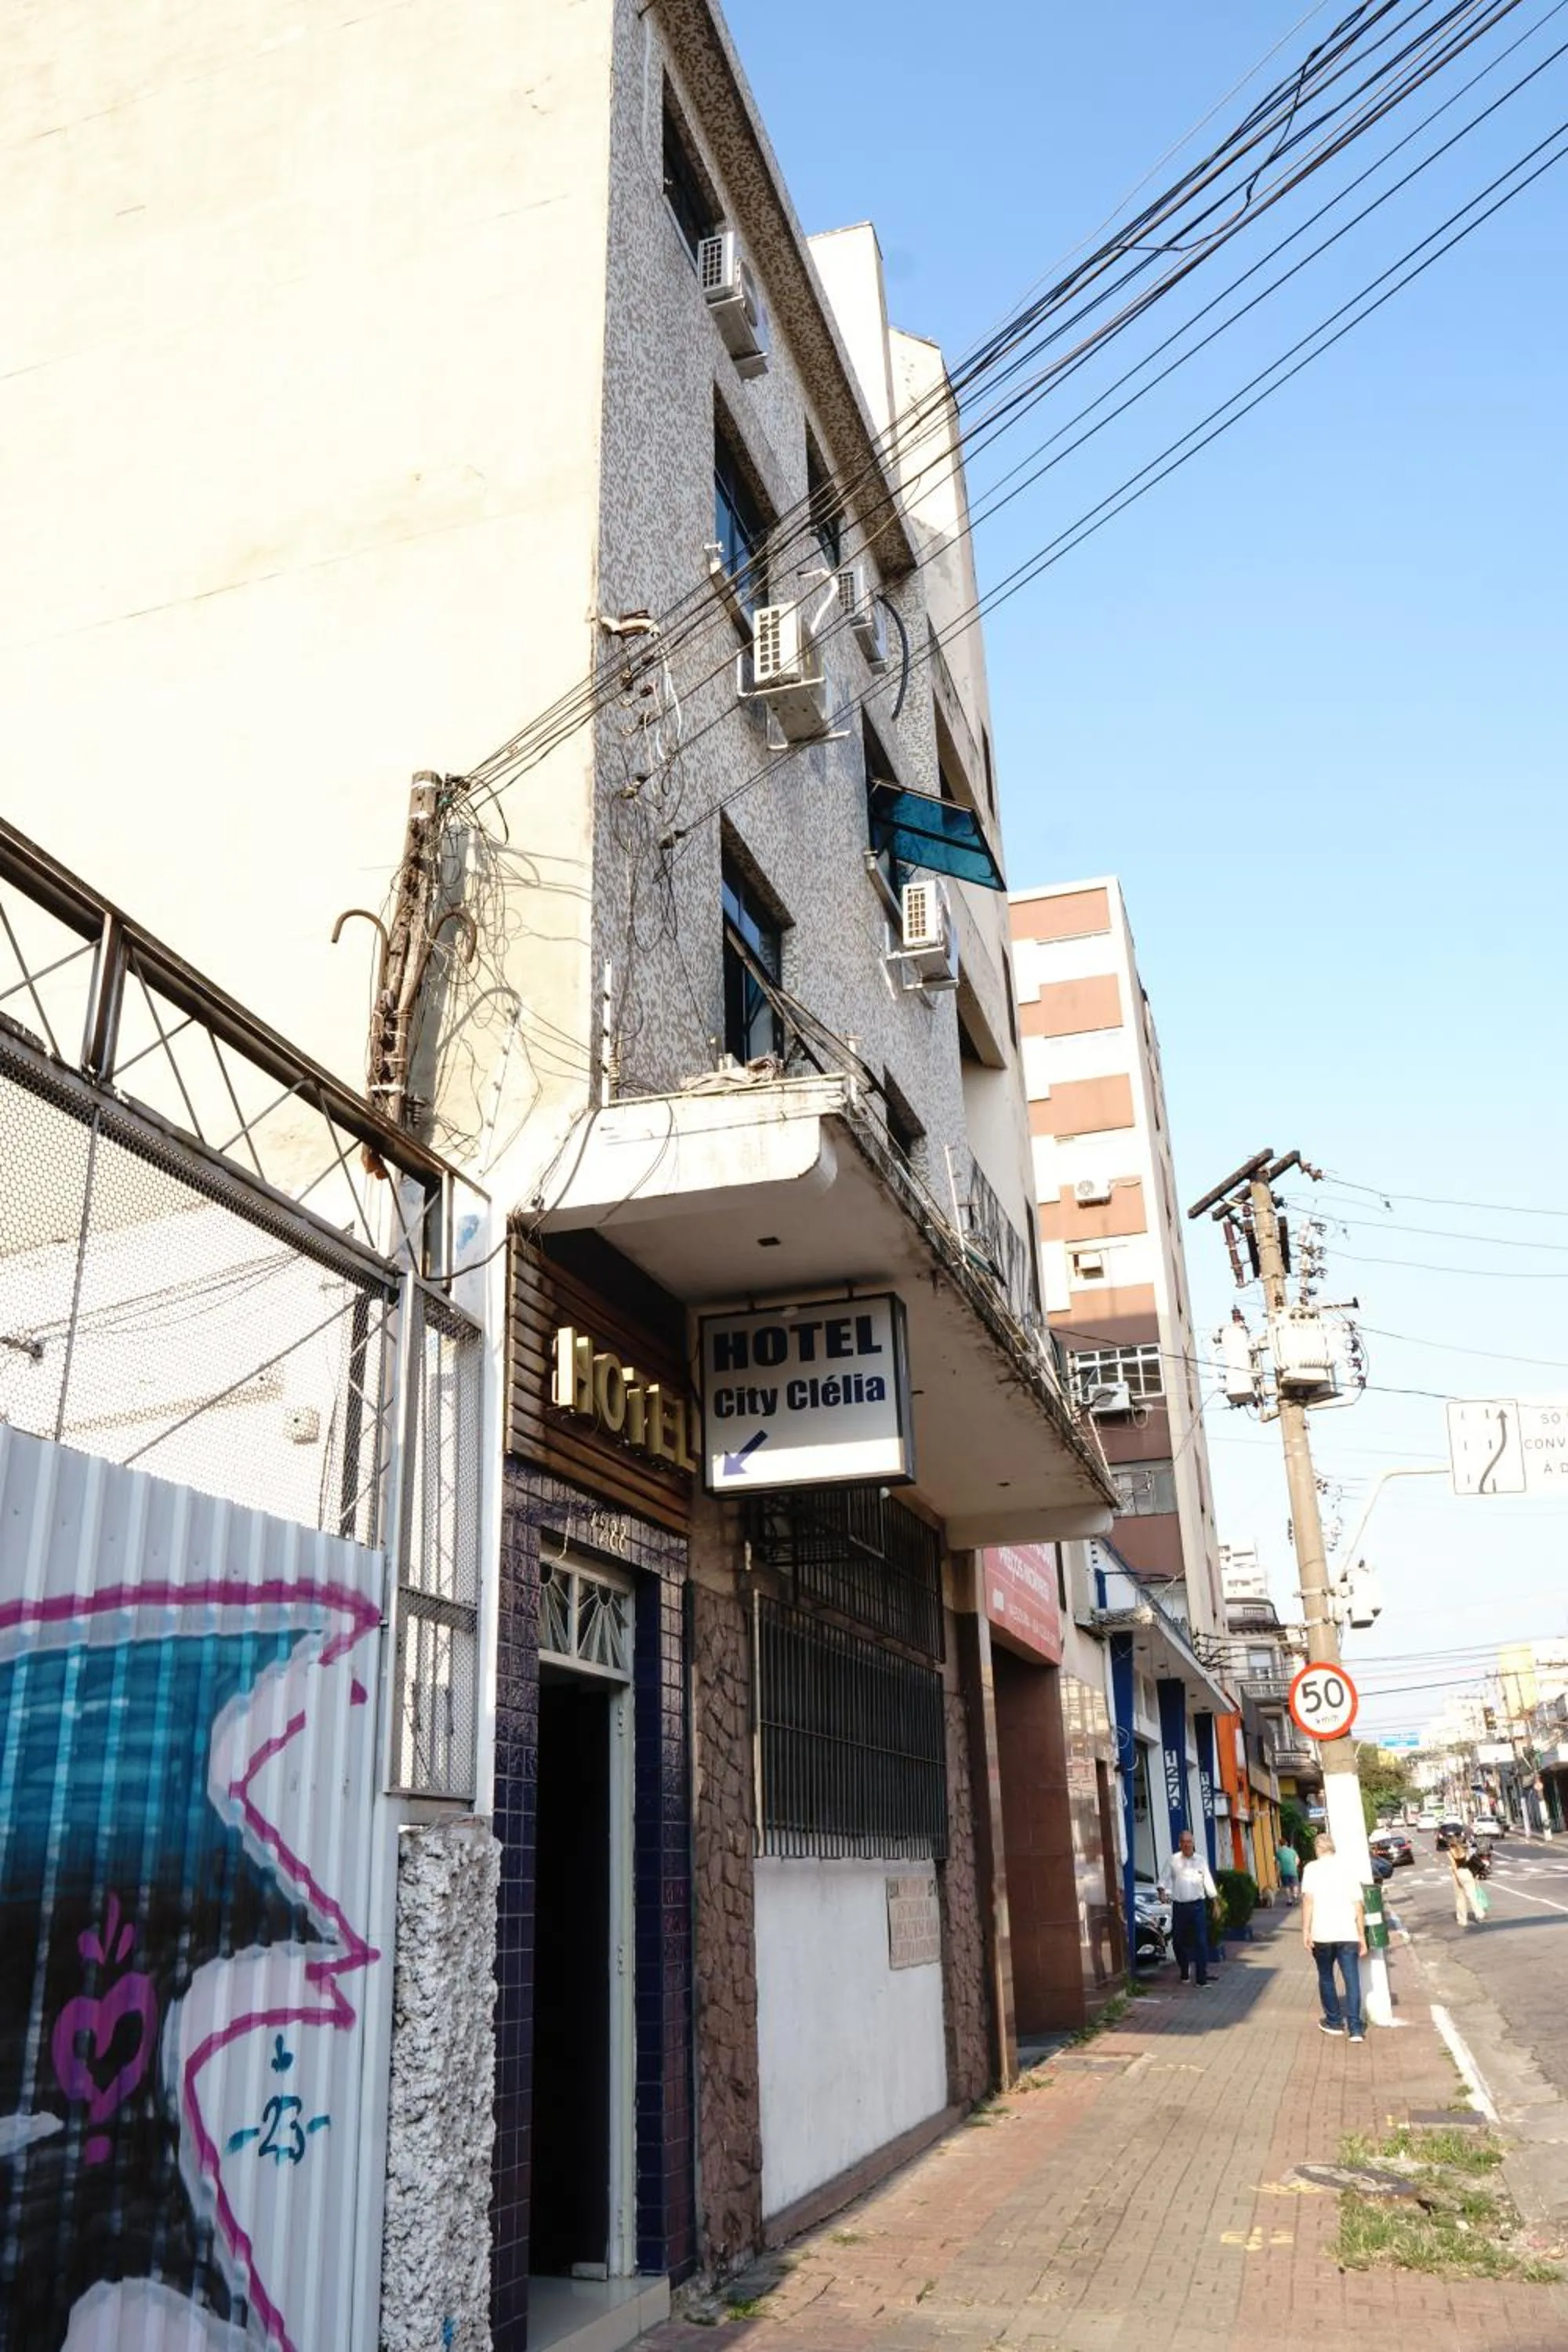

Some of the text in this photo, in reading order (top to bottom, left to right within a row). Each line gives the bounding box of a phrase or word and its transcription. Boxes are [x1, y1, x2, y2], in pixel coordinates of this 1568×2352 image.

[713, 1315, 882, 1371] HOTEL
[552, 1327, 696, 1472] HOTEL
[713, 1373, 886, 1418] City Clélia
[1301, 1677, 1345, 1713] 50
